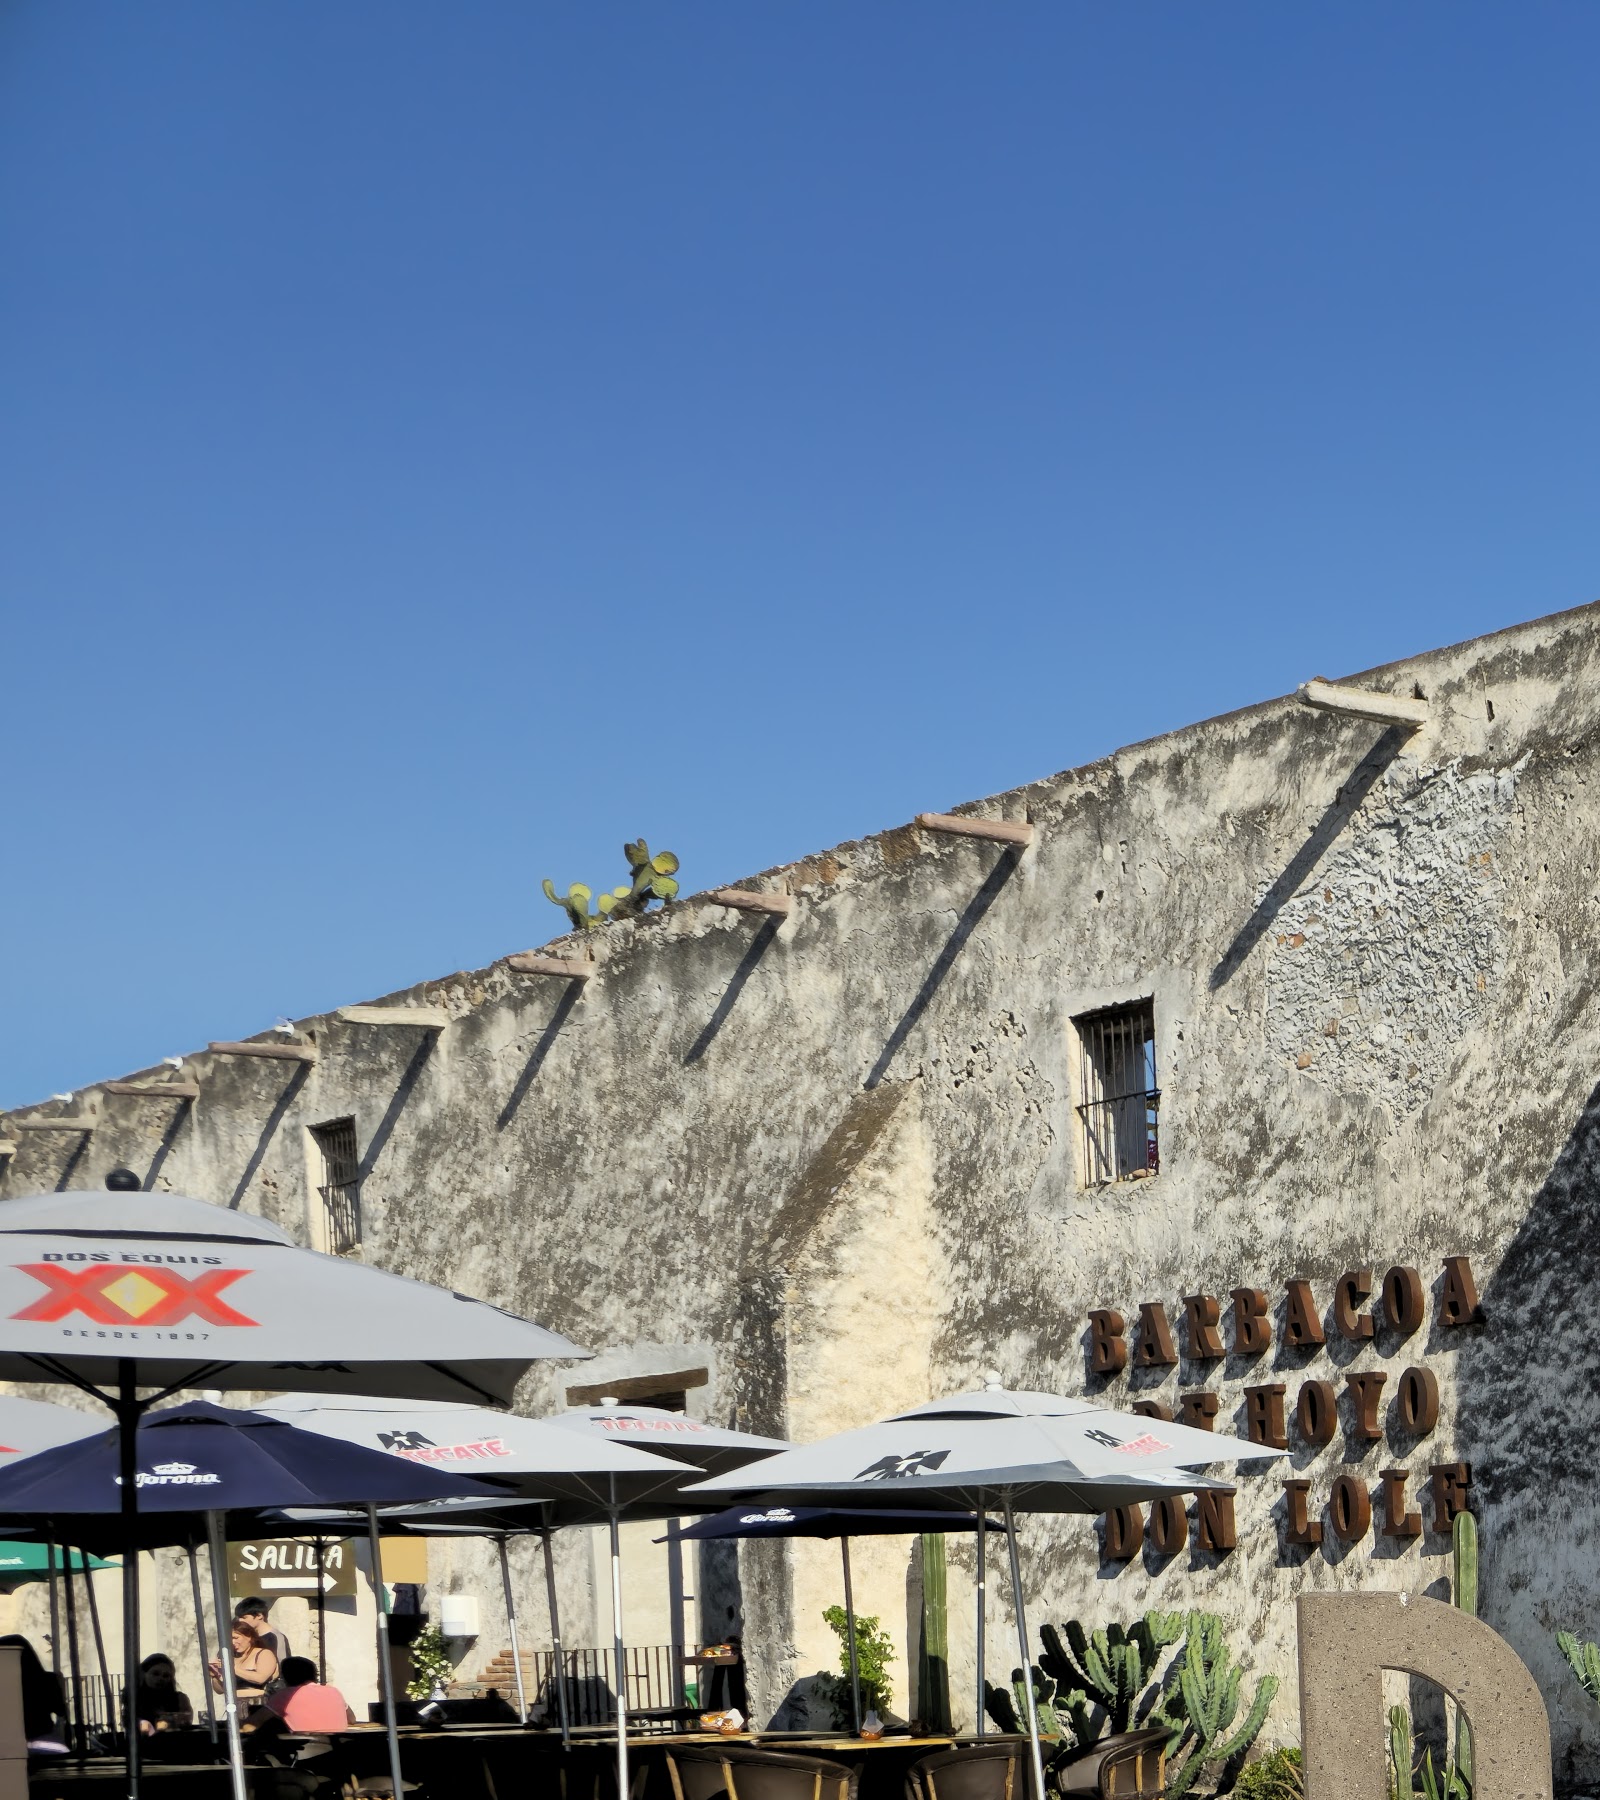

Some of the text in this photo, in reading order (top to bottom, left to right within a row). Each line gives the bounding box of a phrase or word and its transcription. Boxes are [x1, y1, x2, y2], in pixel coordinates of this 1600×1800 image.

[42, 1253, 223, 1265] DOS EQUIS
[1087, 1256, 1486, 1373] BARBACOA
[62, 1329, 210, 1340] DESDE 1897
[1243, 1366, 1439, 1449] HOYO
[394, 1439, 512, 1462] TECATE
[740, 1513, 796, 1524] Corona
[1105, 1462, 1471, 1559] DON LOLE
